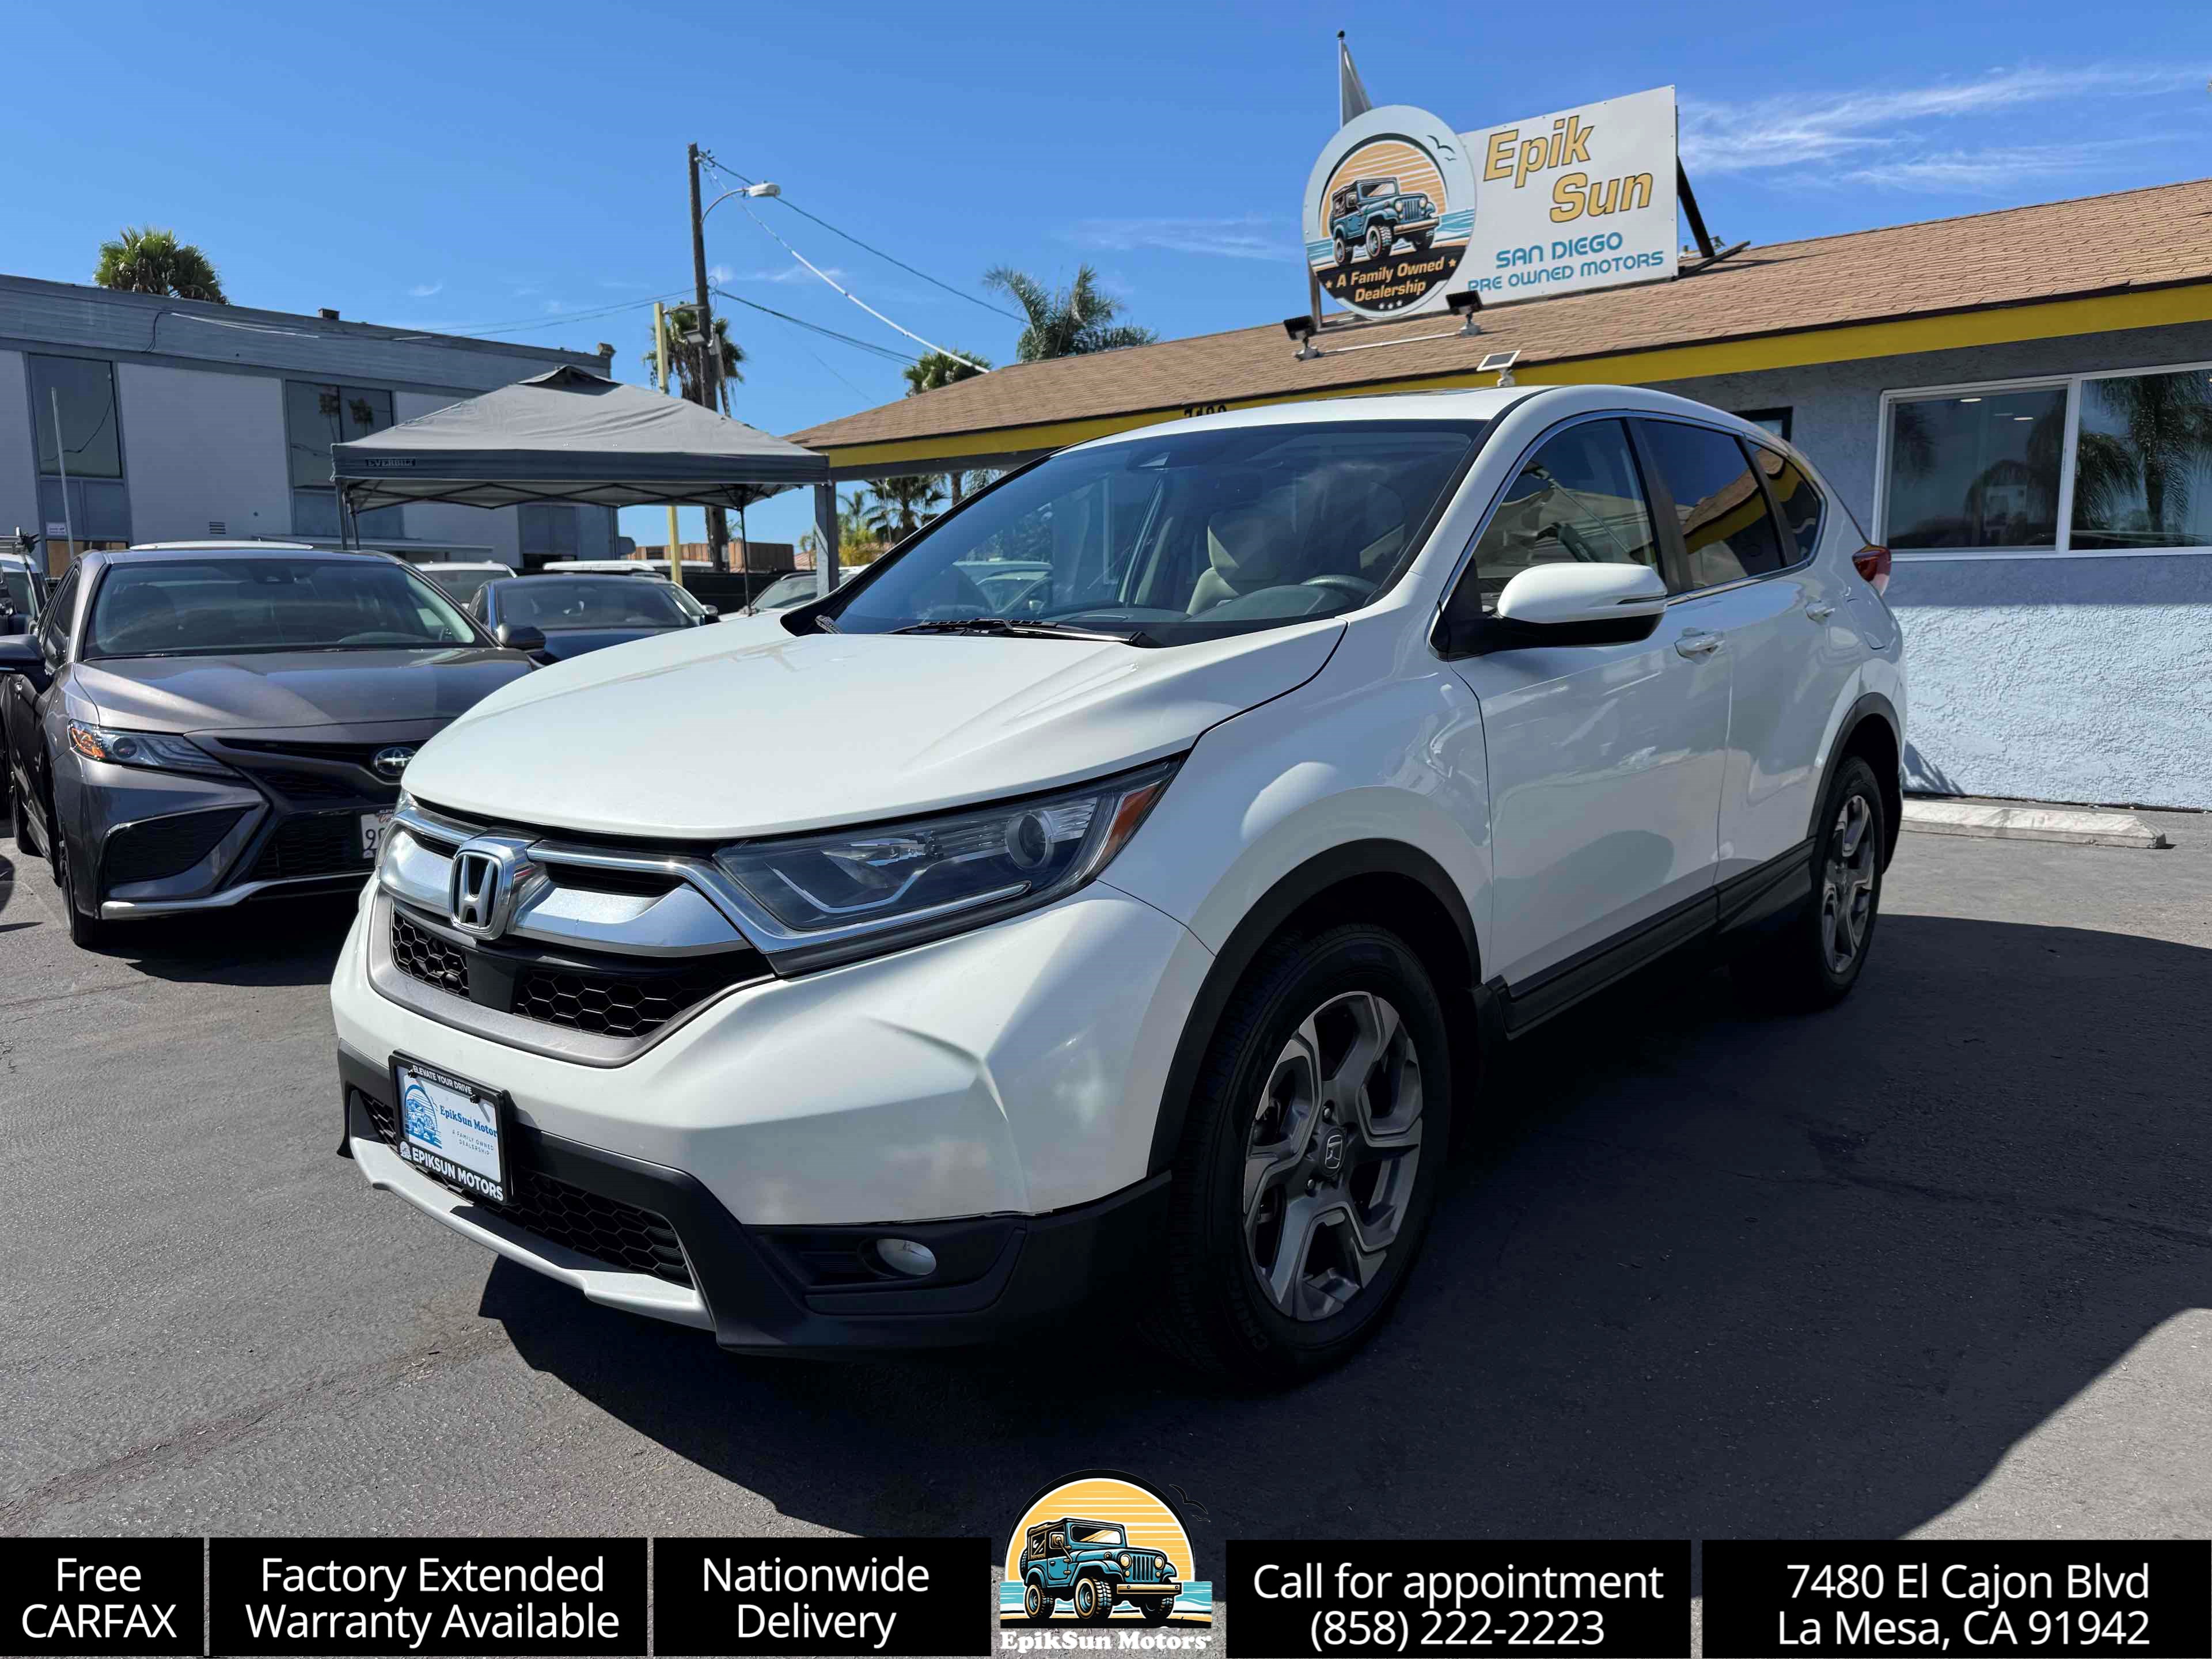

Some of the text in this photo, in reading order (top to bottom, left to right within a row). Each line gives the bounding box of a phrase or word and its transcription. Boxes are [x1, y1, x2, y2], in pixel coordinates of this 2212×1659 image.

[1483, 115, 1595, 188] Epik
[1549, 172, 1653, 223] Sun
[1496, 231, 1623, 269] SAN DIEGO
[1336, 256, 1444, 288] A Family Owned
[1468, 250, 1664, 293] PRE OWNED MOTORS
[1354, 279, 1426, 302] Dealership
[413, 1065, 472, 1095] ELEVATE YOUR DRIVE
[439, 1105, 472, 1127] EpikSun
[476, 1139, 494, 1151] OWNED
[412, 1147, 504, 1201] EPIKSUN MOTORS
